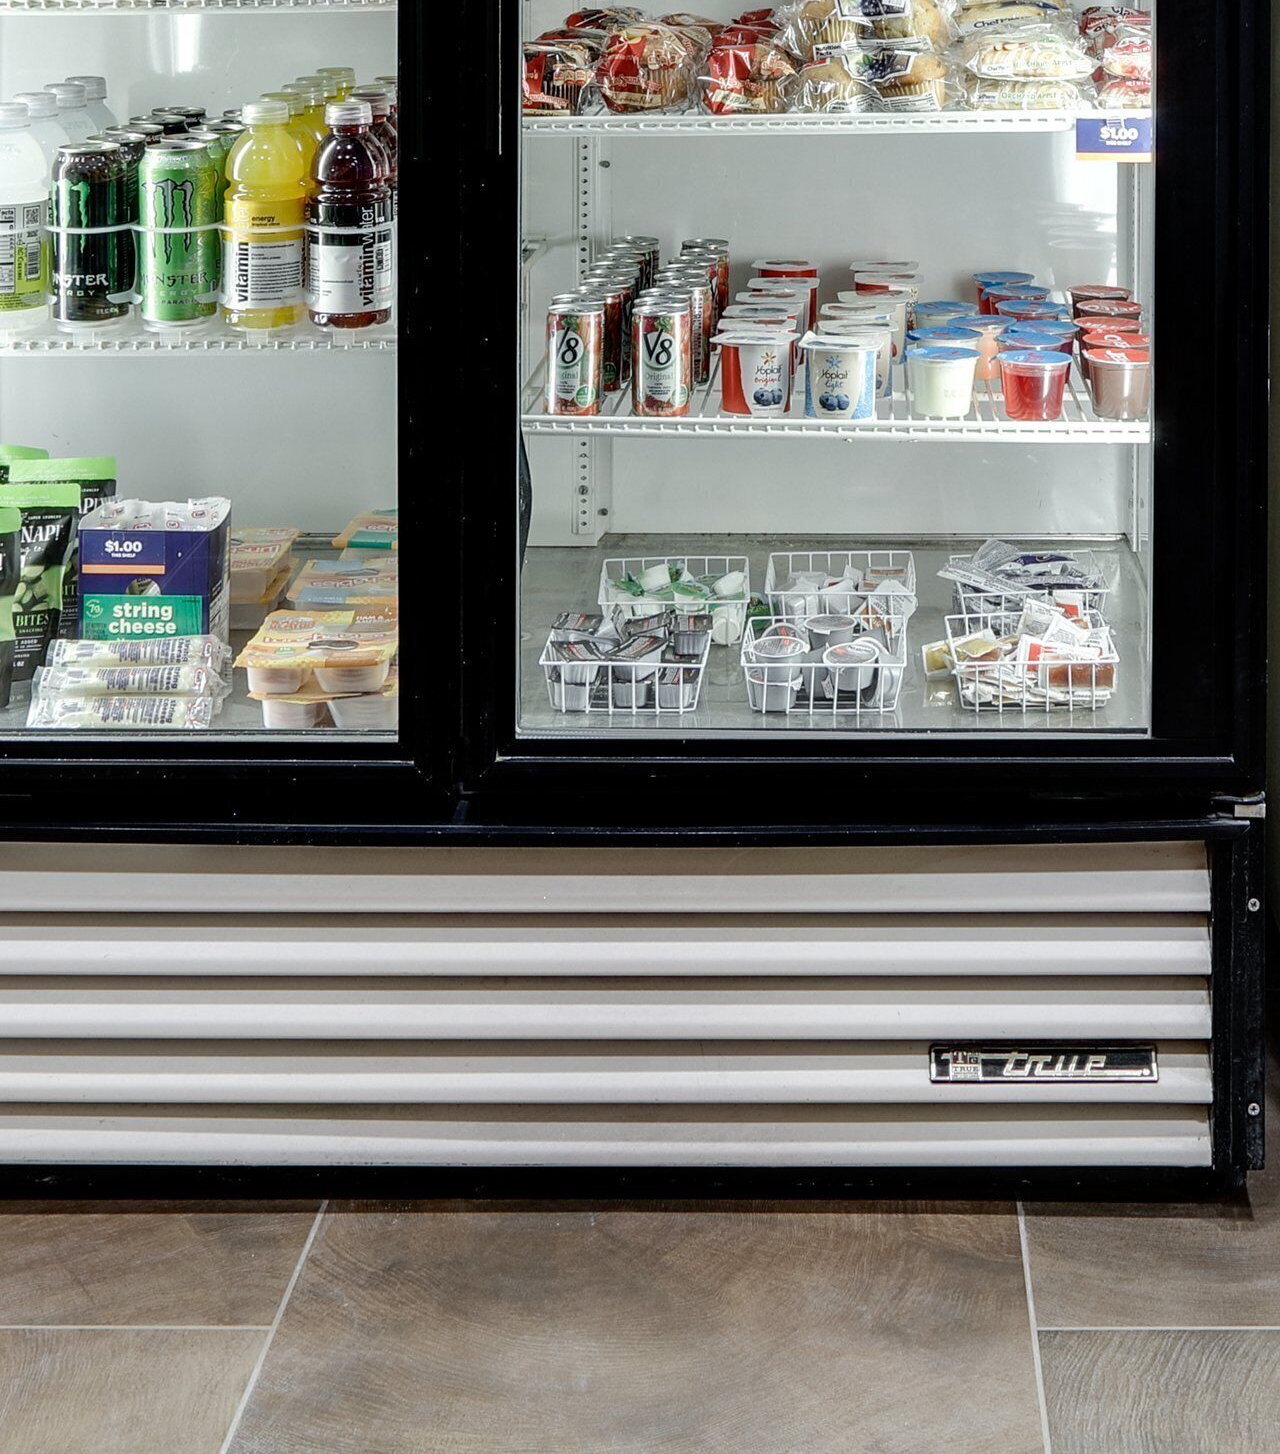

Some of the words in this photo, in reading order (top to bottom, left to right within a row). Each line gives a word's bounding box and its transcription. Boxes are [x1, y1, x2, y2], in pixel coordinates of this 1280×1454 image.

[1099, 125, 1139, 141] $1.00
[251, 215, 276, 224] energy
[643, 327, 673, 366] V8
[754, 364, 782, 378] Yoplait
[821, 369, 849, 382] Yoplait
[104, 539, 143, 554] $1.00
[112, 601, 173, 621] string
[16, 613, 50, 627] BITES
[108, 618, 177, 635] cheese
